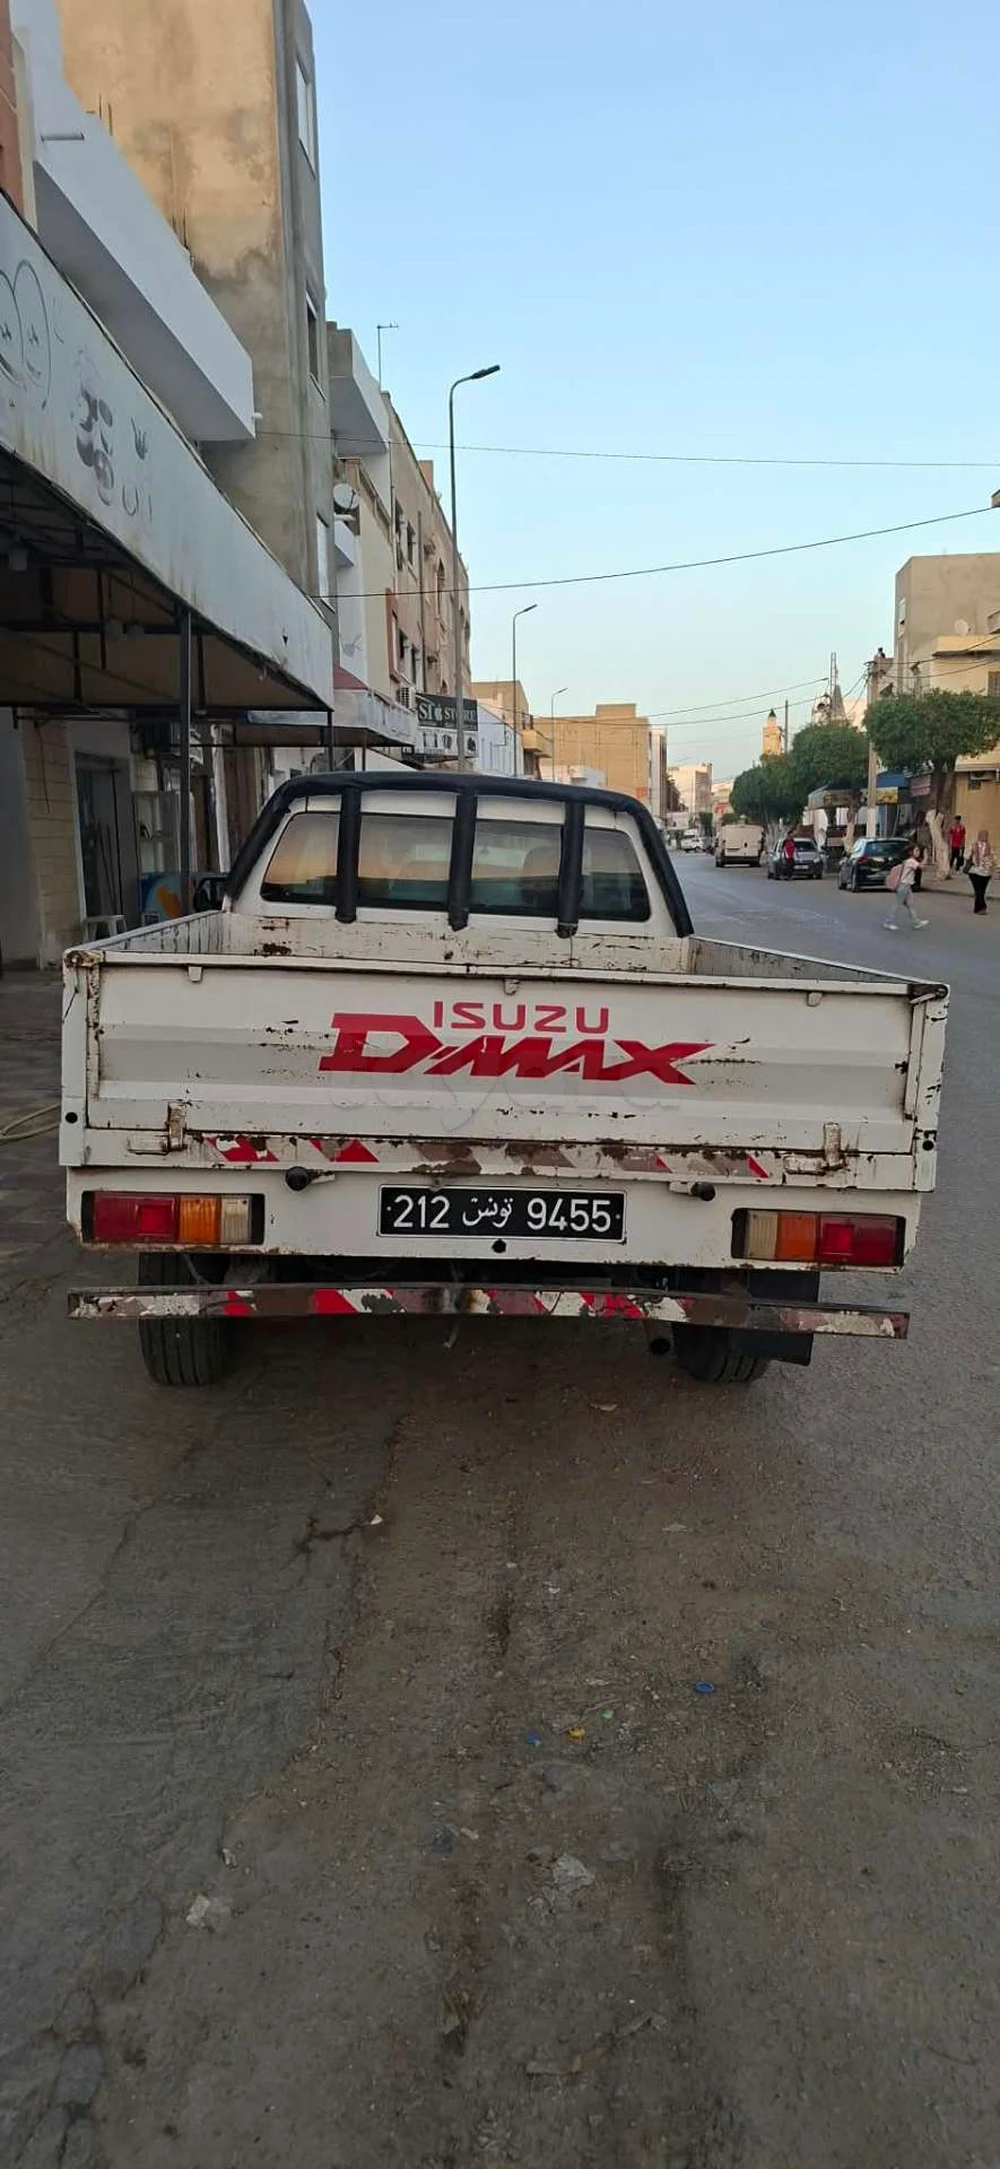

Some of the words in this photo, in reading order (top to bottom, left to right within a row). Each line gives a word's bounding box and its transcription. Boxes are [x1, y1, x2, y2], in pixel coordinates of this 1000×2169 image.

[434, 1001, 609, 1034] ISUZU
[318, 1012, 716, 1085] D-MAX
[393, 1195, 450, 1228] 212
[462, 1197, 514, 1228] تونس
[527, 1198, 611, 1232] 9455
